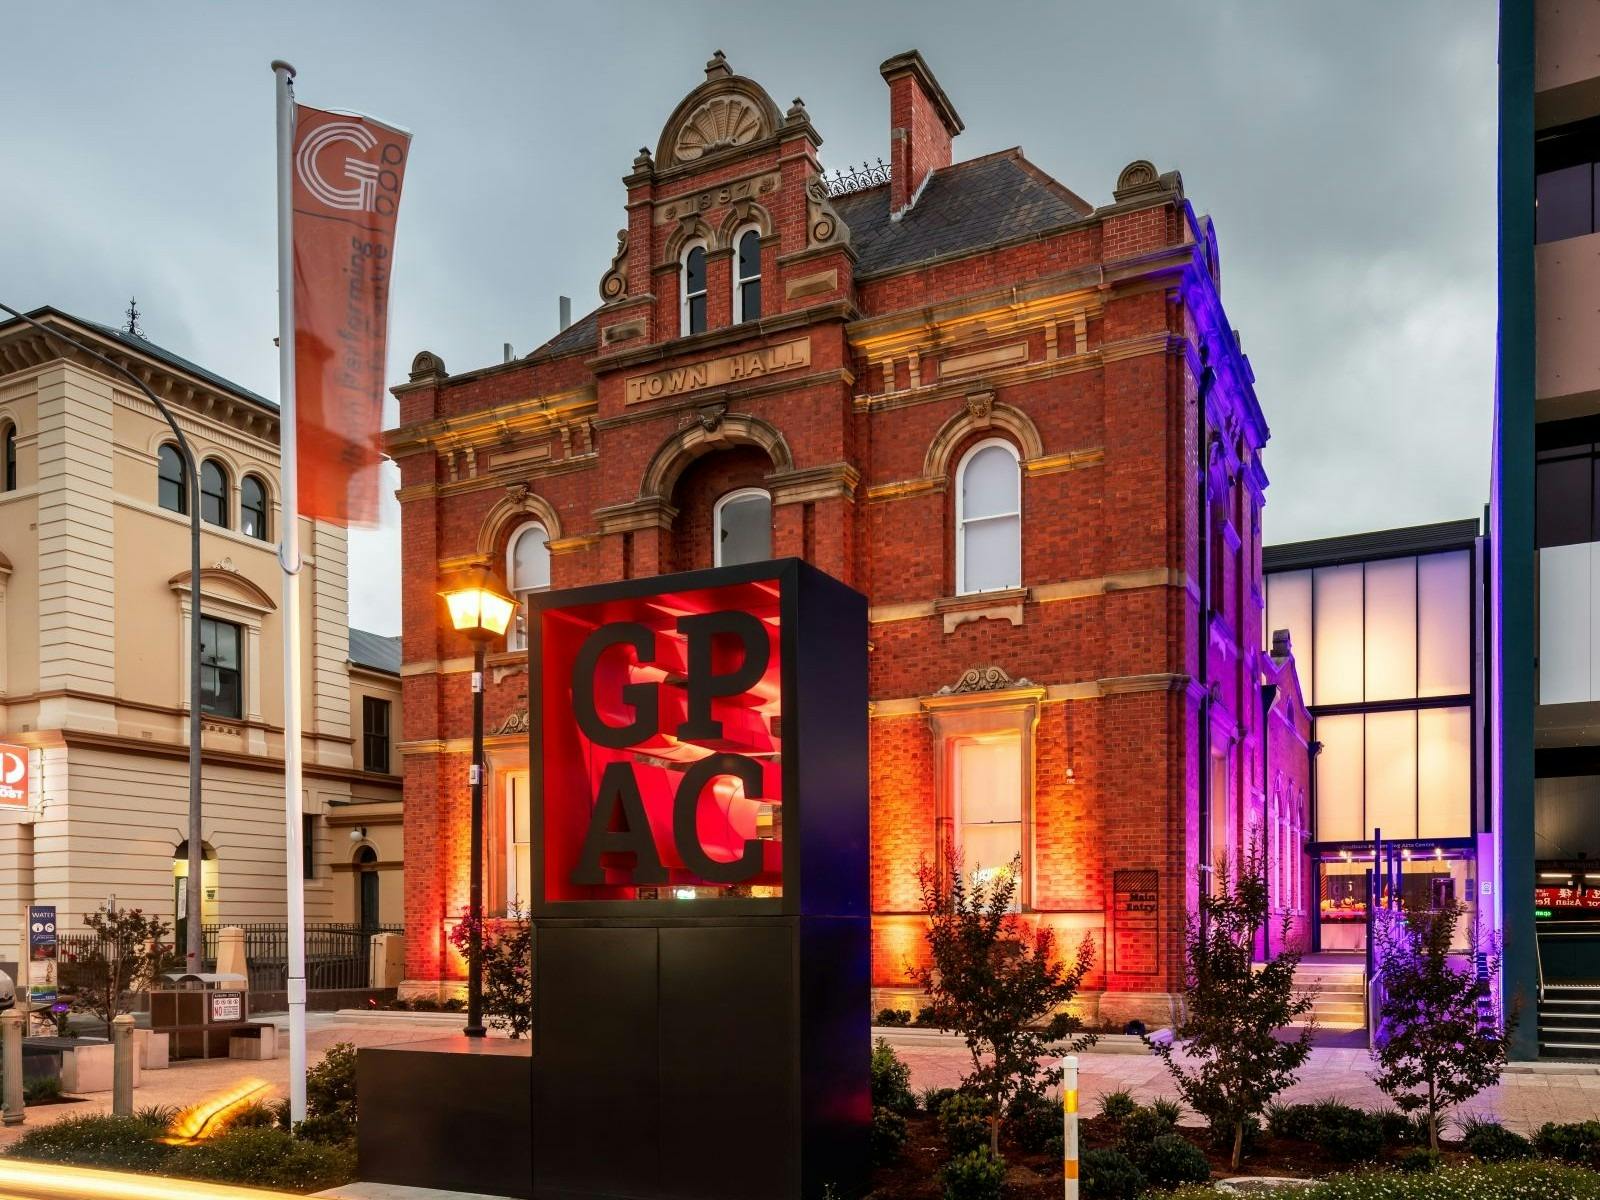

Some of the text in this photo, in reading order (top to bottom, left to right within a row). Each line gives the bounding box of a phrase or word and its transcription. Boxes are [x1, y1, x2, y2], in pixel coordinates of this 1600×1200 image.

[687, 183, 752, 212] 1887
[632, 342, 804, 400] TOWN HALL
[1130, 892, 1156, 901] Main
[1126, 903, 1156, 913] Entry
[214, 1006, 222, 1017] NO
